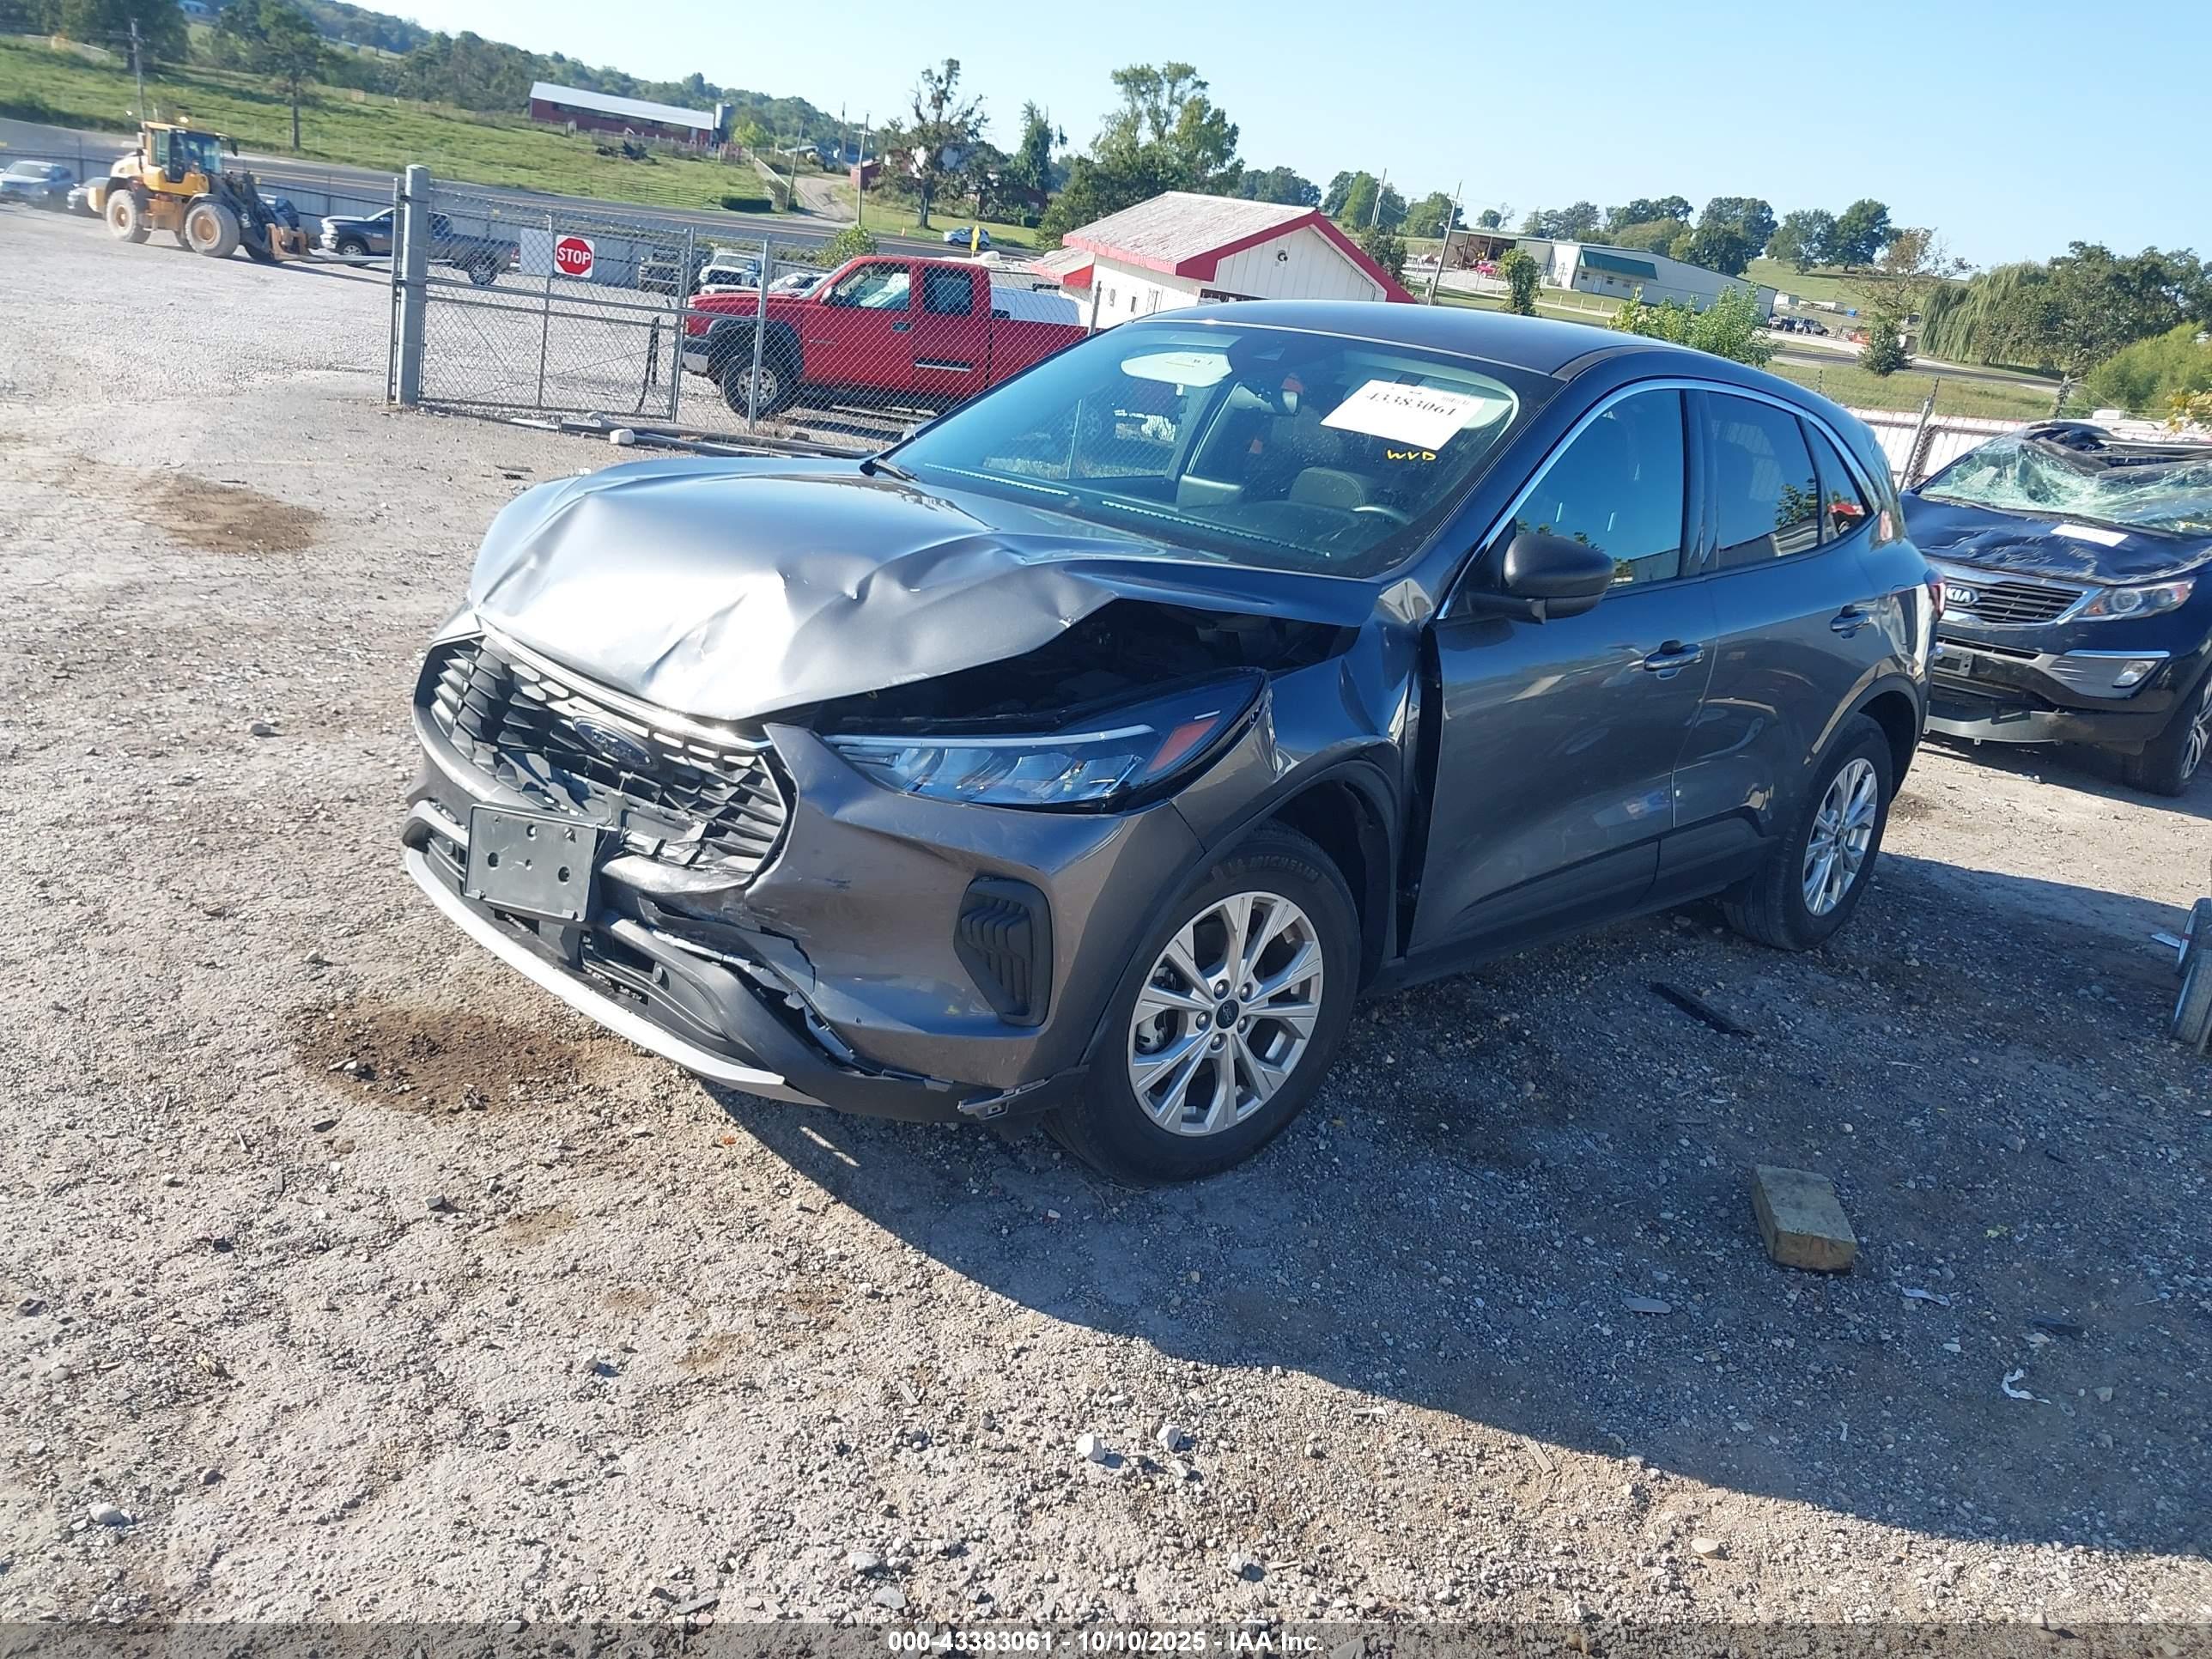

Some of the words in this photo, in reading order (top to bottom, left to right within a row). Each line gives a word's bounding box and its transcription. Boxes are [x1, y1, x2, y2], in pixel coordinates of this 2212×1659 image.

[557, 247, 592, 265] STOP
[1367, 392, 1456, 416] 43383061
[1946, 588, 1971, 603] KIA
